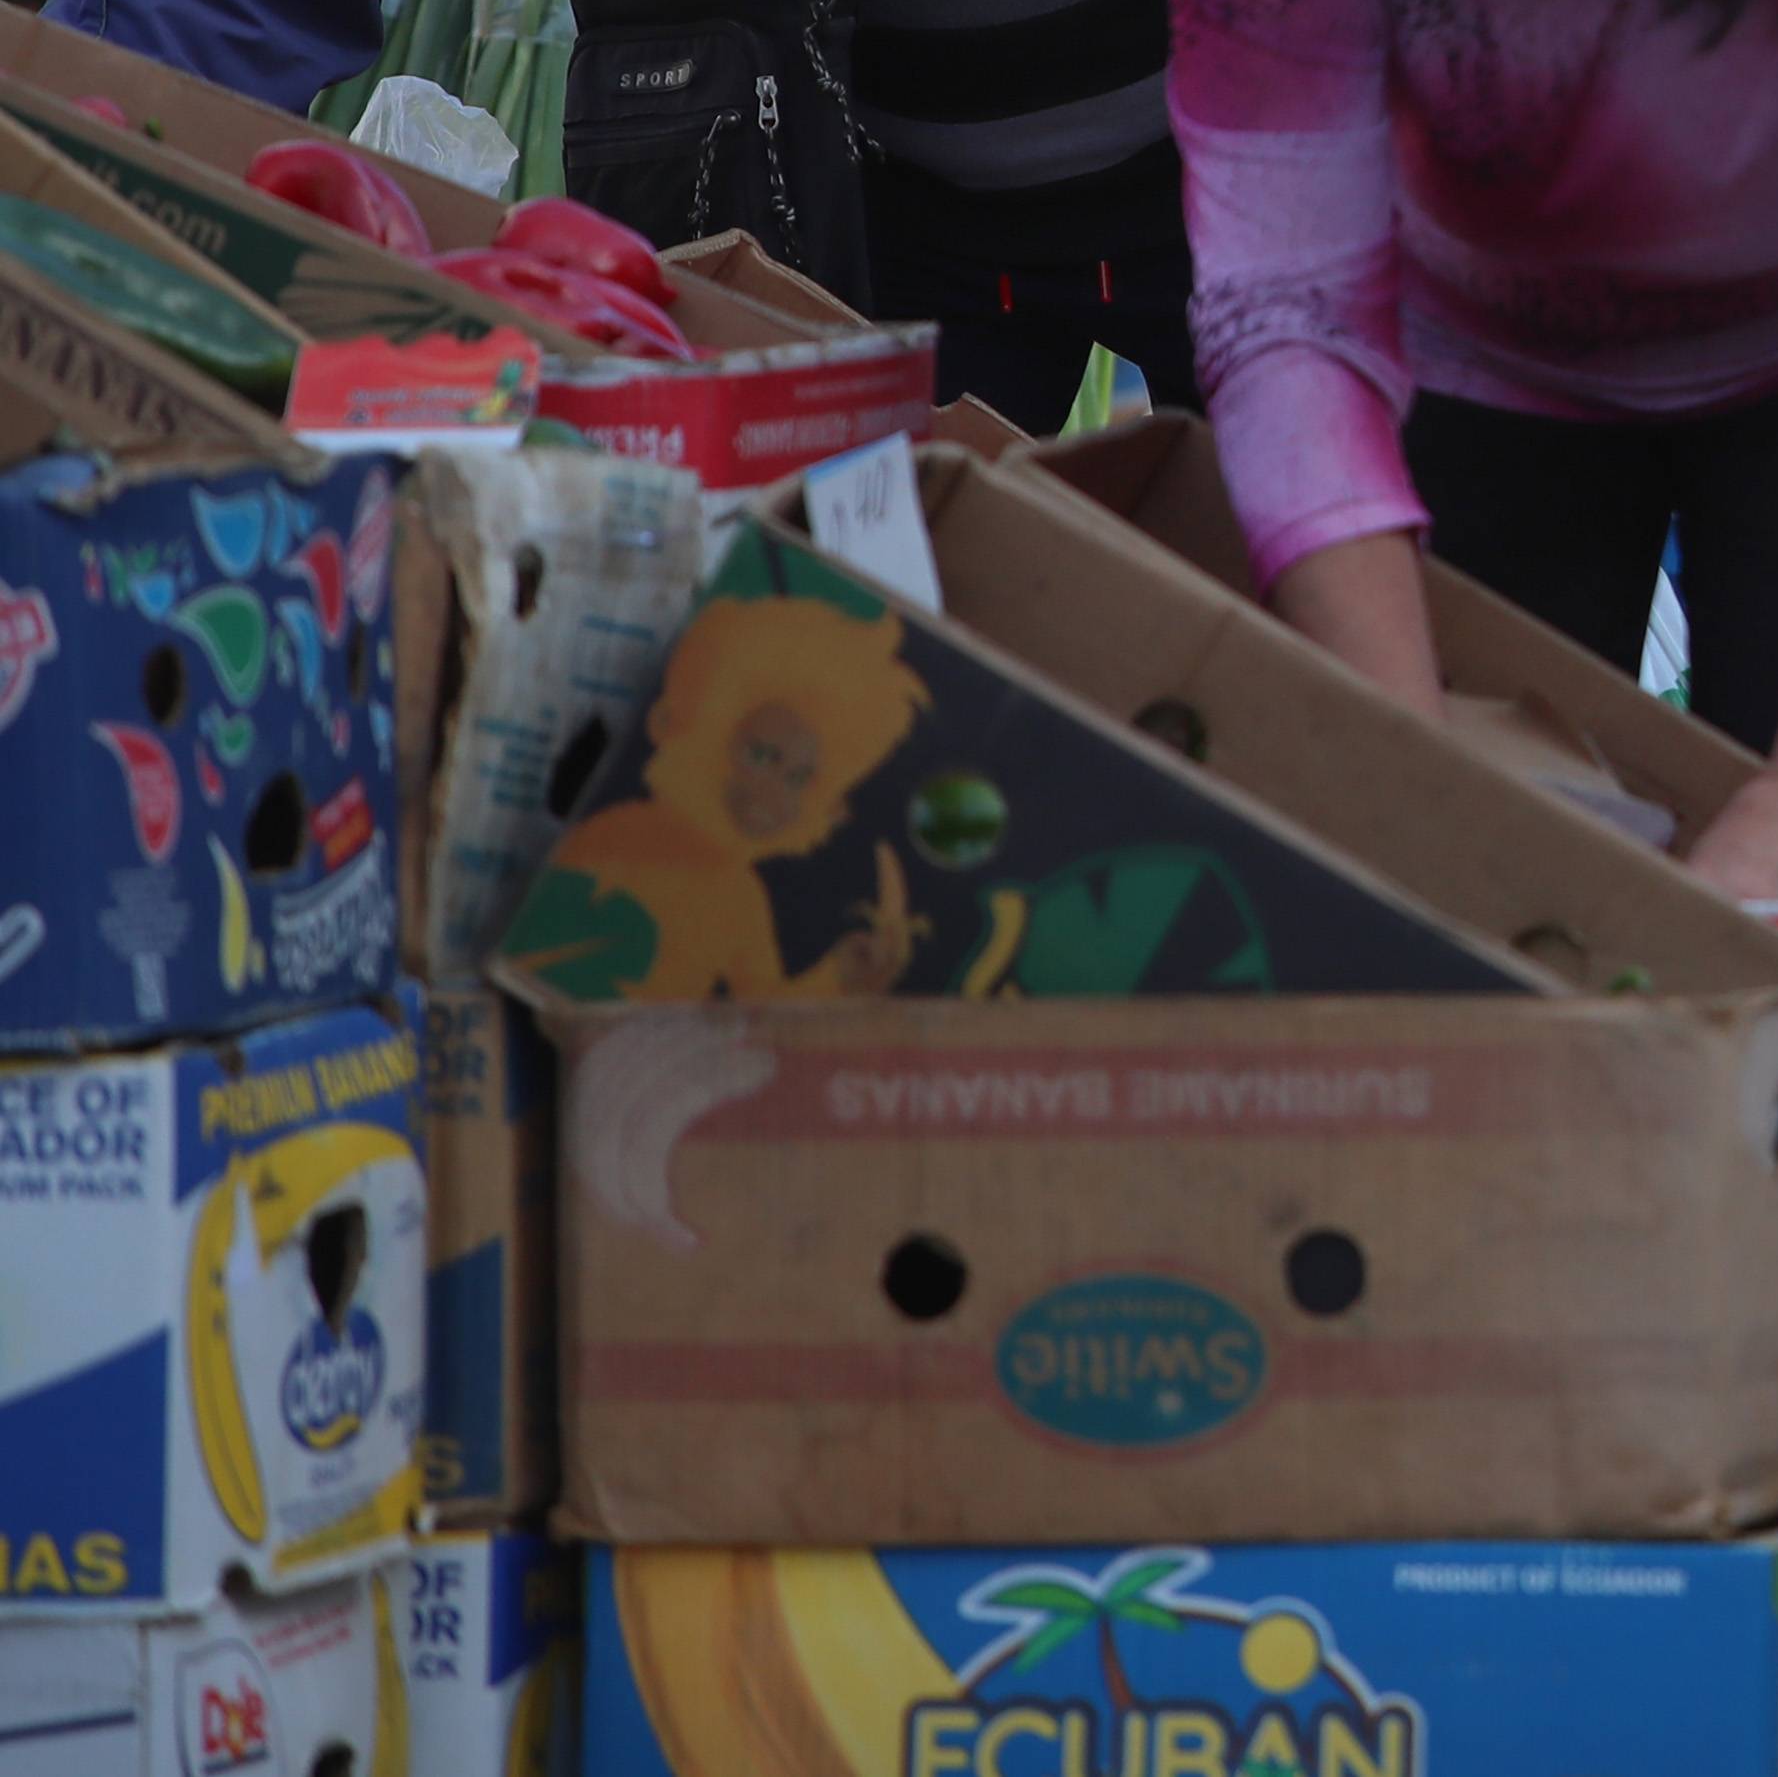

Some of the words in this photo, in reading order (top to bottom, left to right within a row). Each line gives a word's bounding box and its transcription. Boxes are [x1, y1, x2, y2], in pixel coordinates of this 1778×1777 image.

[619, 66, 687, 89] SPORT
[77, 1080, 147, 1118] OF
[828, 1068, 1110, 1120] BANANAS
[0, 1121, 145, 1163] ADOR
[0, 1528, 131, 1596] AS
[1394, 1564, 1513, 1594] PRODUCT
[1522, 1566, 1554, 1594] OF
[1560, 1567, 1687, 1596] ECUADOR
[200, 1673, 267, 1762] Dole
[911, 1706, 1406, 1777] ECUBAN
